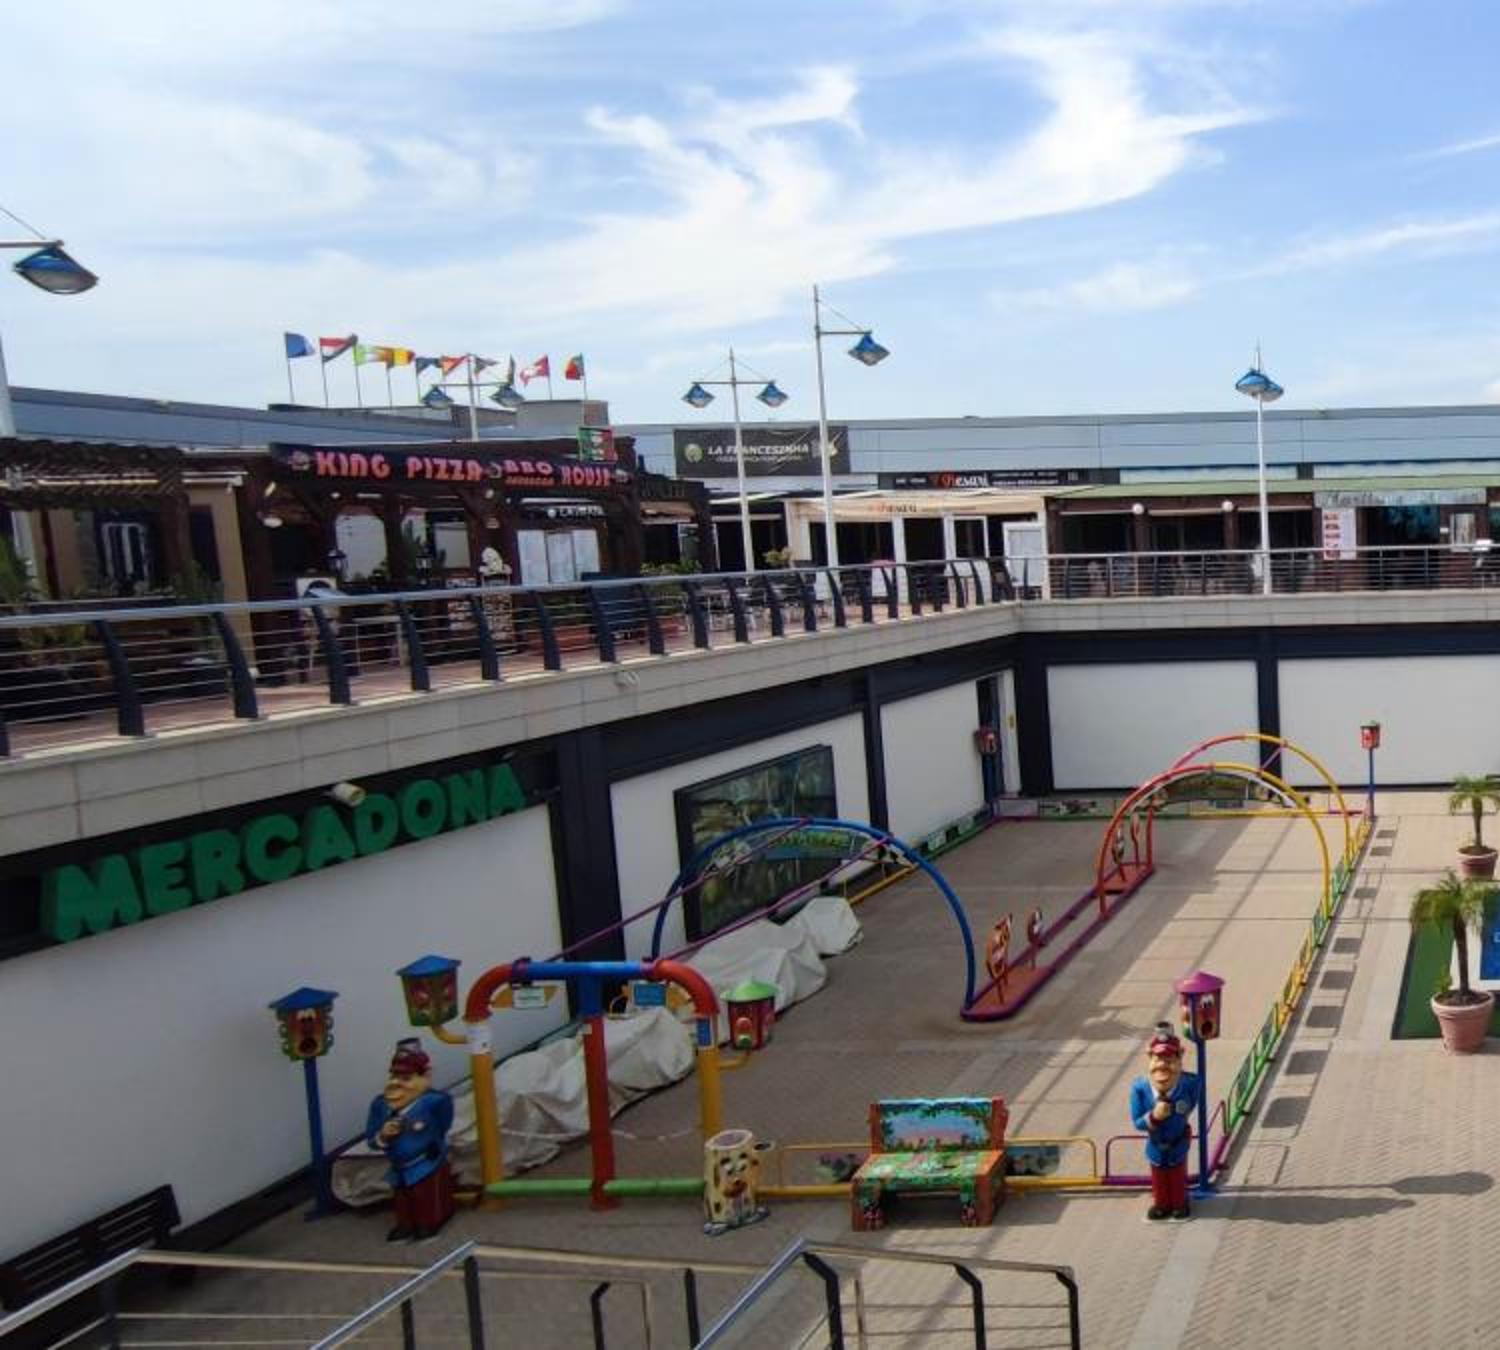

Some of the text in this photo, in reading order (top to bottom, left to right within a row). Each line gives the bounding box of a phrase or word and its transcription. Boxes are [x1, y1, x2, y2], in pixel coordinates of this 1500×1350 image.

[315, 451, 391, 479] KING
[406, 457, 482, 481] PIZZA
[50, 764, 527, 944] MERCADONA
